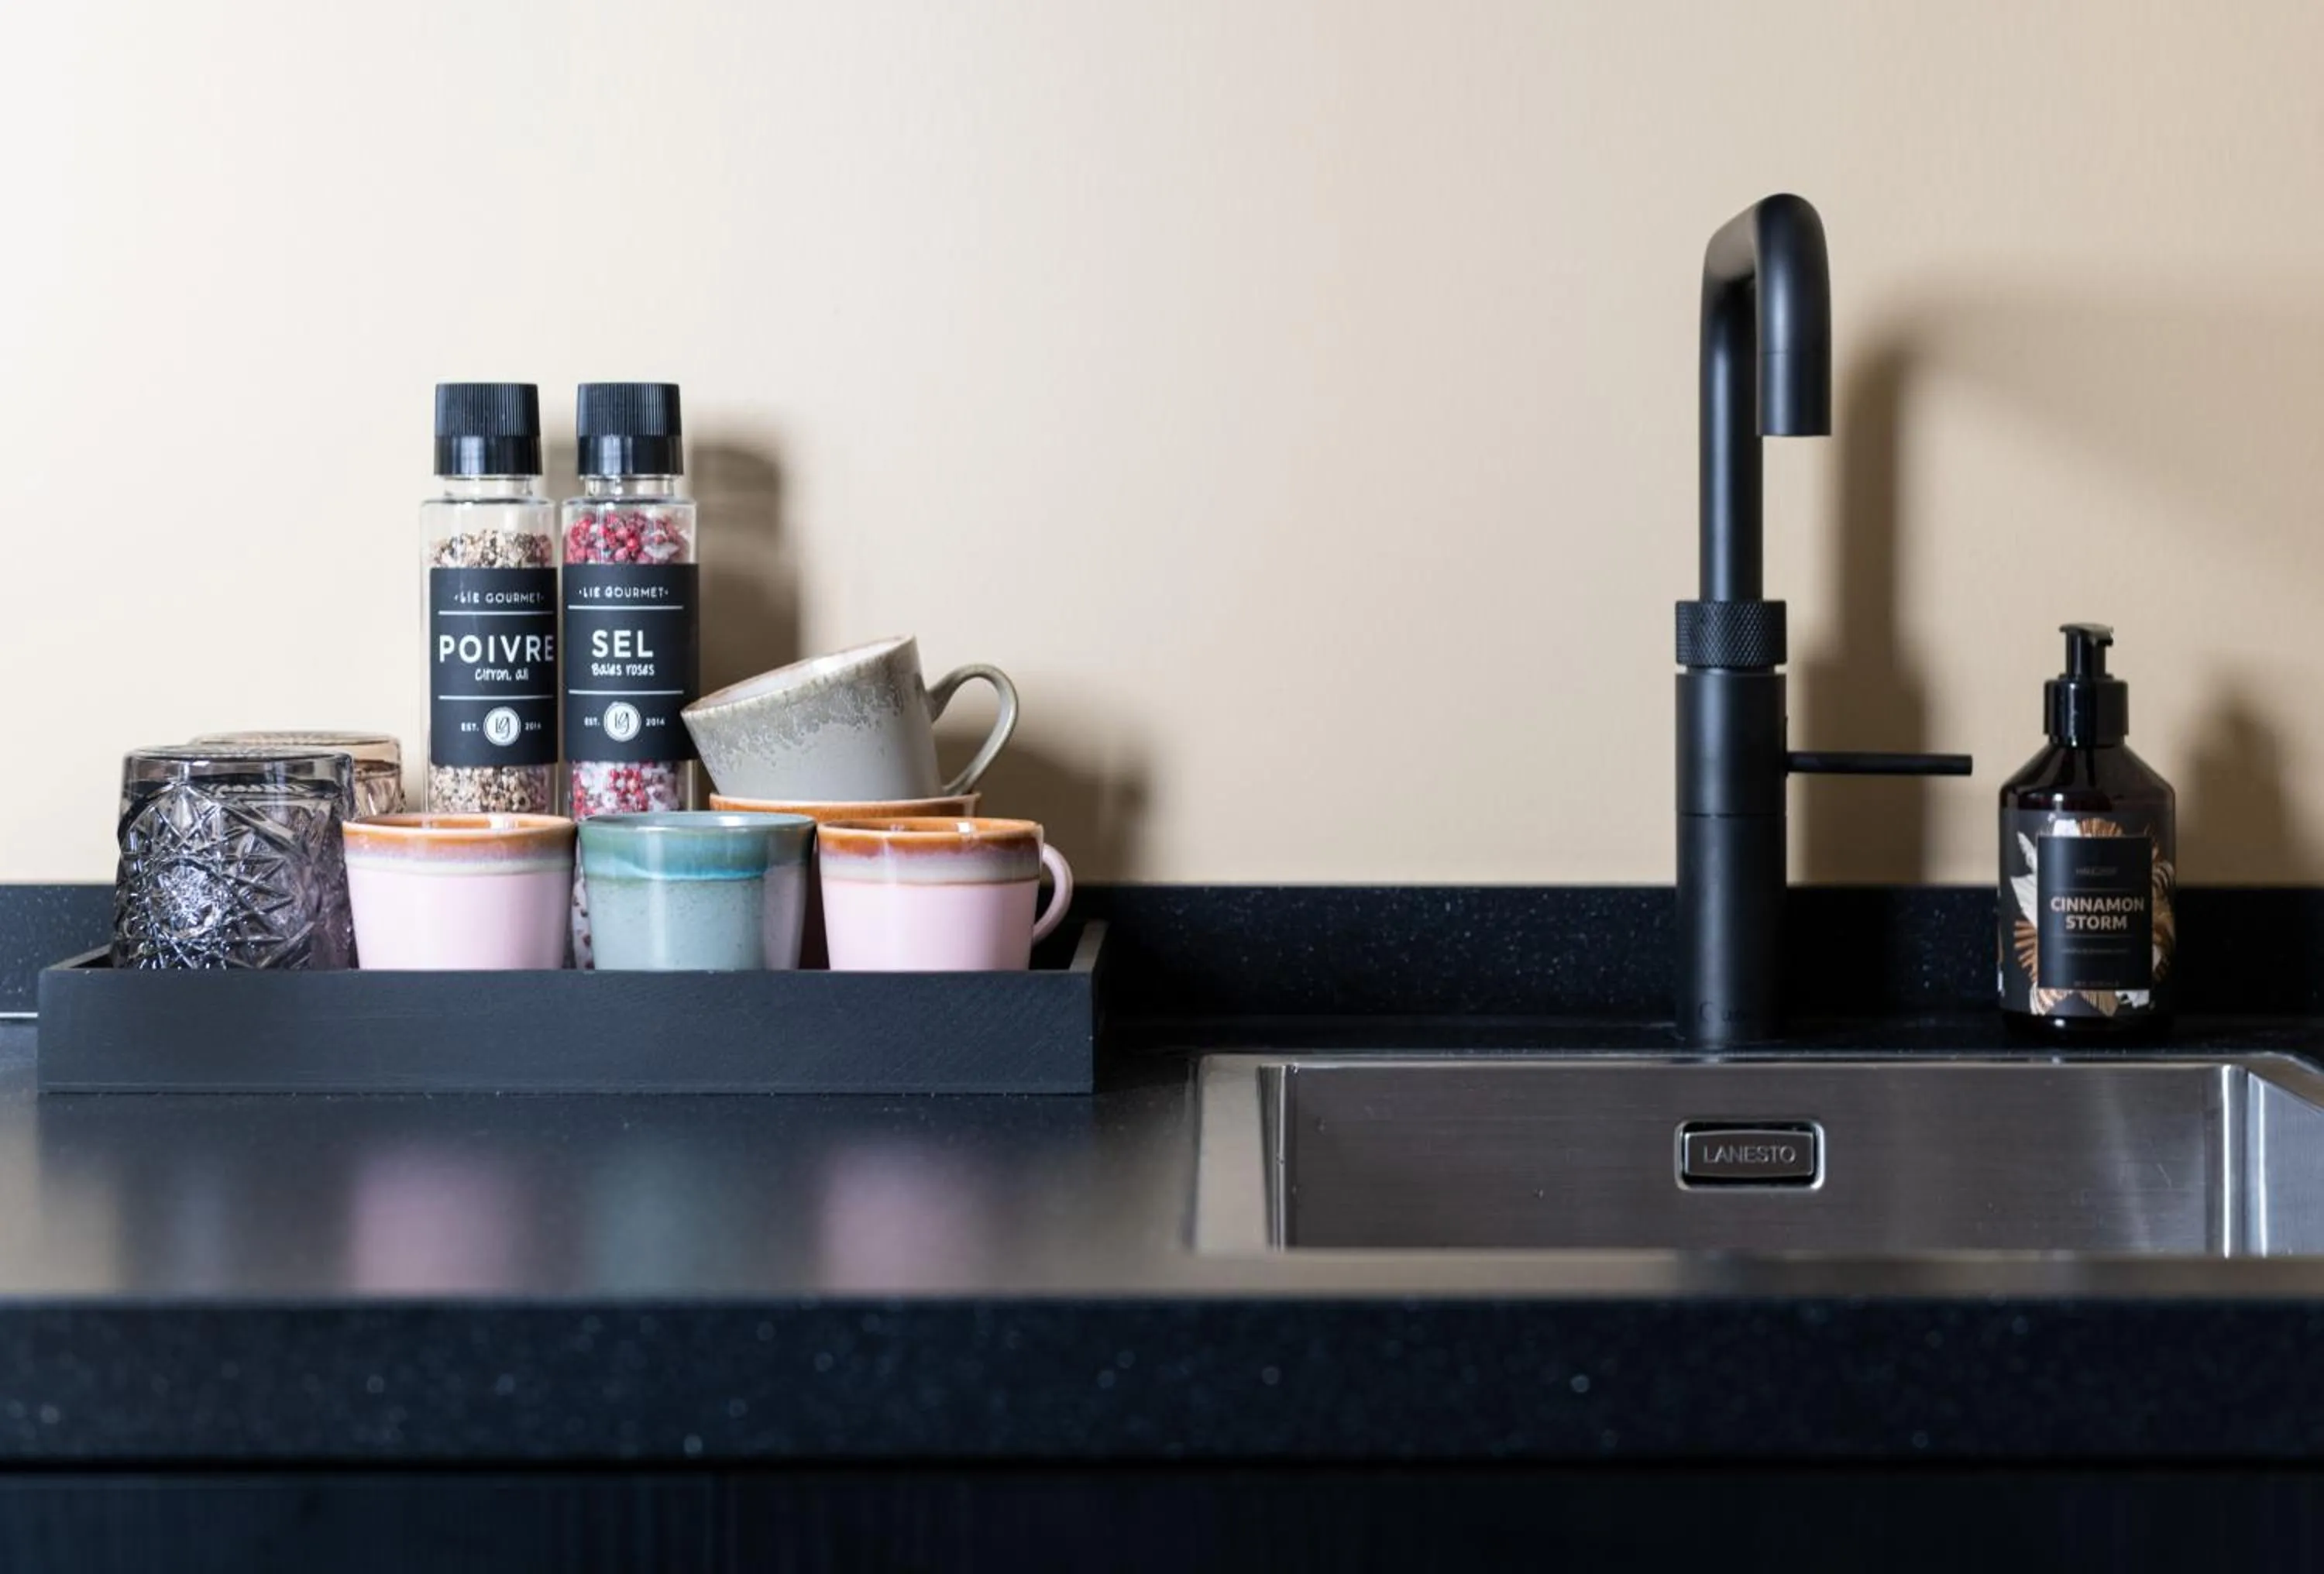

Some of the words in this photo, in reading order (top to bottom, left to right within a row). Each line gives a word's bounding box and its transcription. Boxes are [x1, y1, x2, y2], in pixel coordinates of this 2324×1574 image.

[460, 591, 480, 603] LIE
[485, 592, 541, 603] GOURMET
[583, 586, 601, 598] LIE
[604, 586, 664, 599] GOURMET
[439, 634, 554, 663] POIVRE
[592, 629, 654, 658] SEL
[461, 721, 480, 732] EST.
[584, 716, 600, 727] EST.
[2051, 896, 2144, 912] CINNAMON
[2065, 915, 2127, 930] STORM
[1703, 1145, 1796, 1163] LANESTO
